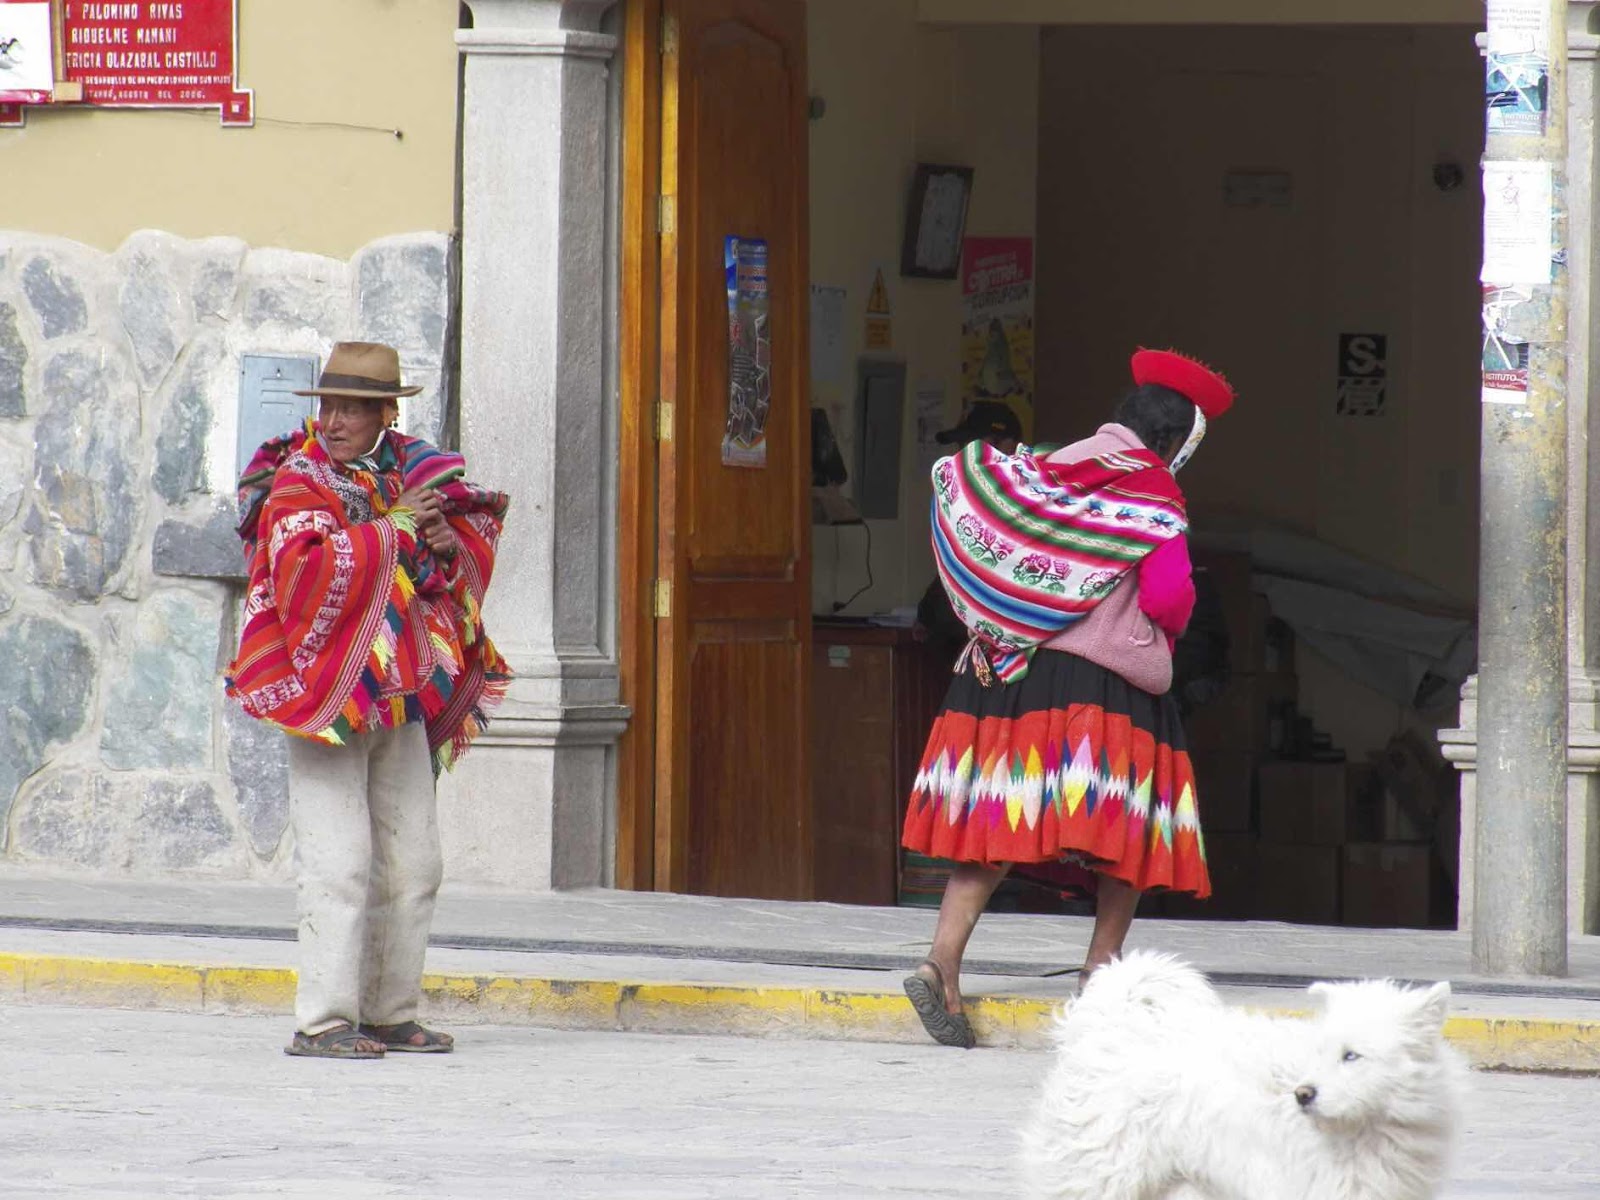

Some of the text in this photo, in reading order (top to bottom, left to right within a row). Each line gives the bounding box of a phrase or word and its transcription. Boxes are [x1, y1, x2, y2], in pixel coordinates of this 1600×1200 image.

[82, 4, 138, 20] PALOMINO
[149, 4, 183, 19] RIVAS
[136, 28, 177, 43] MAMANI
[106, 51, 161, 69] OLAZABAL
[165, 51, 217, 68] CASTILLO
[1346, 336, 1377, 375] S
